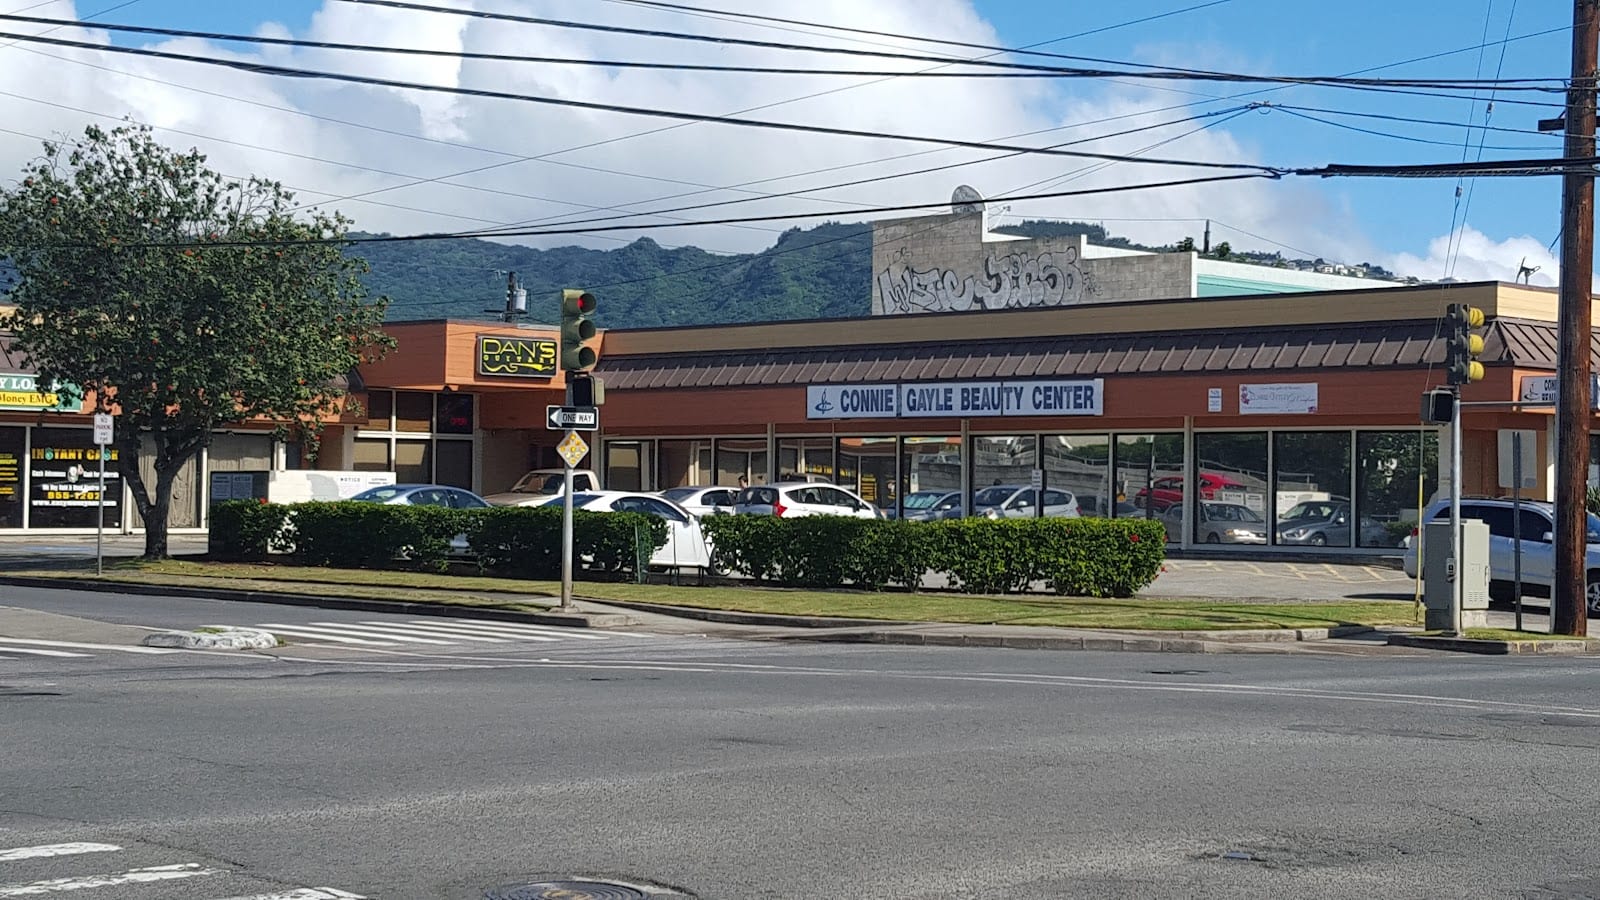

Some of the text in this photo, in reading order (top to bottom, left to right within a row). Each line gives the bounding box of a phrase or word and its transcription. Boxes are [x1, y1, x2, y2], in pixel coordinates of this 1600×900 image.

[483, 339, 555, 358] DAN'S
[29, 394, 53, 404] EMG
[840, 385, 1094, 412] CONNIE GAYLE BEAUTY CENTER
[562, 413, 592, 422] ONE WAY
